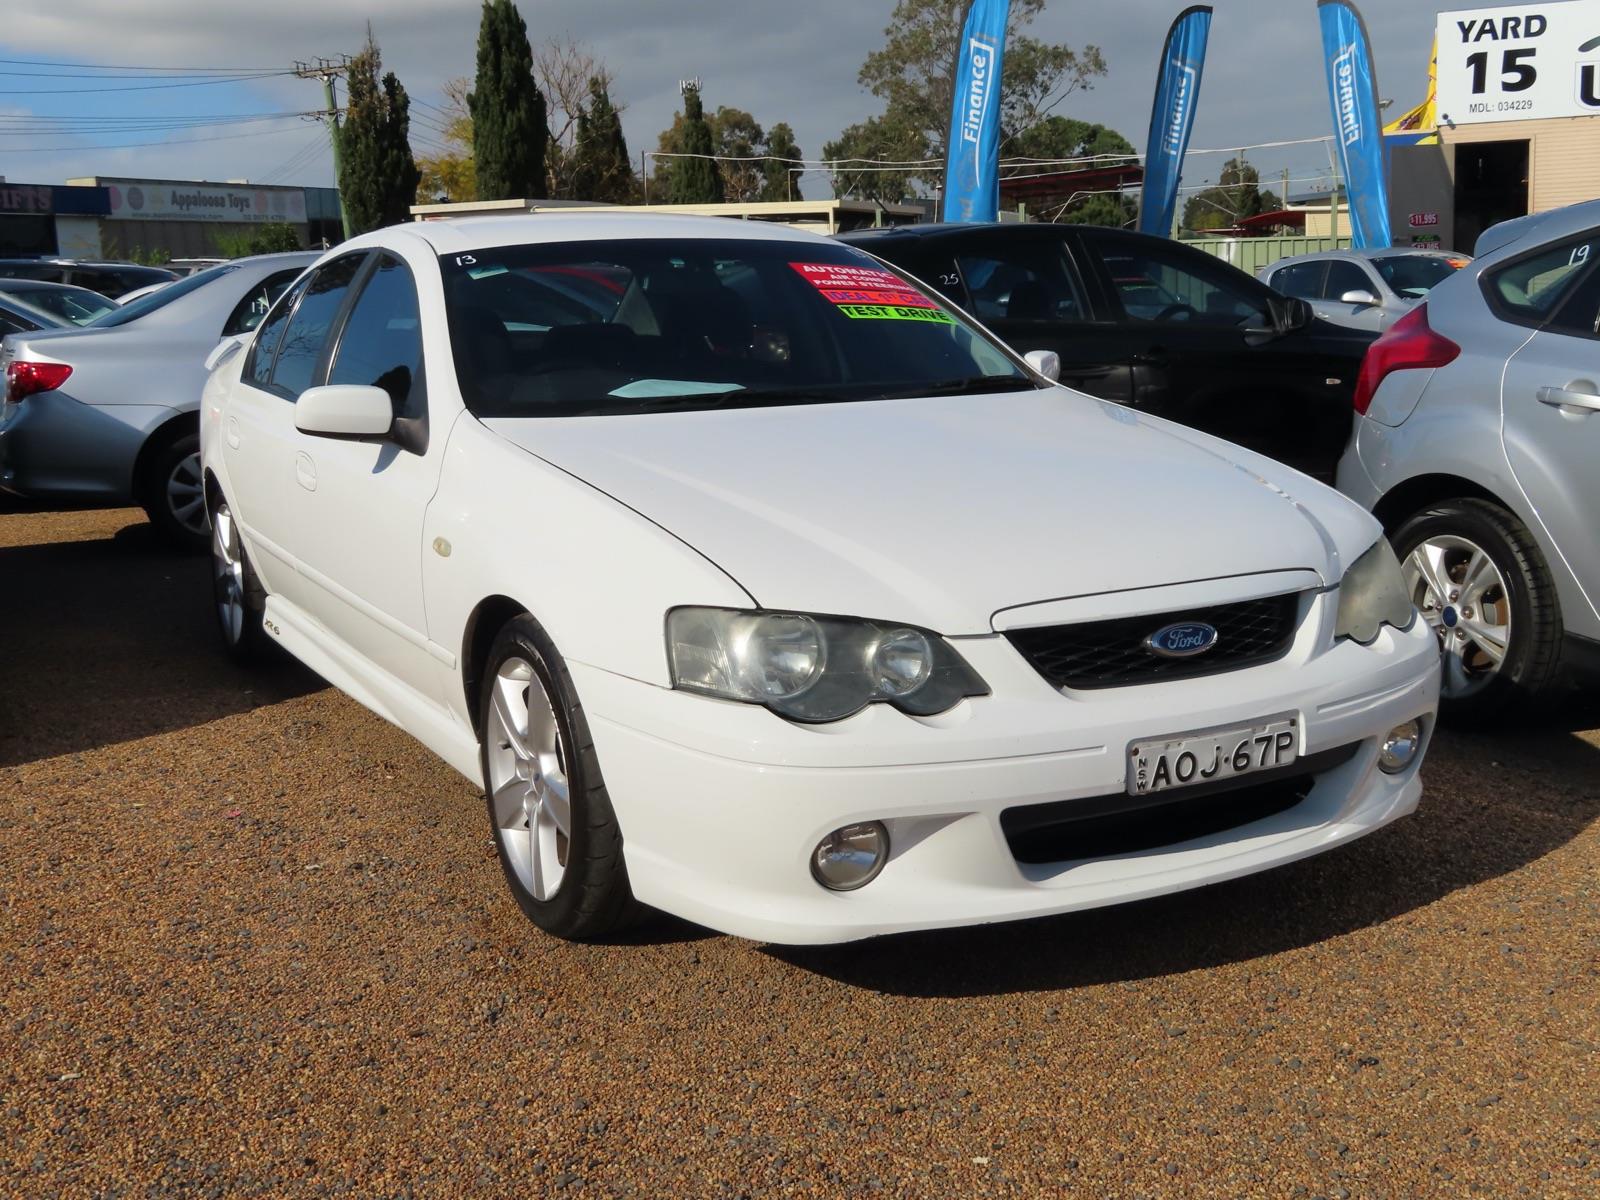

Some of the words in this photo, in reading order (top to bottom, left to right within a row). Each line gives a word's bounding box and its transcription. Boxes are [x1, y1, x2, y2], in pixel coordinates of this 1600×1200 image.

[1457, 14, 1547, 43] YARD
[1466, 48, 1537, 94] 15
[963, 53, 986, 144] Finance
[1469, 103, 1494, 113] MDL:
[1498, 100, 1533, 112] 034229
[1164, 75, 1187, 156] Finance
[171, 190, 226, 211] Appaloosa
[227, 193, 250, 213] Toys
[456, 255, 477, 266] 13
[1568, 244, 1590, 267] 19
[813, 279, 857, 287] POWER
[939, 273, 959, 285] 25
[840, 306, 891, 316] TEST
[893, 307, 951, 321] DRIVE
[1167, 628, 1204, 650] Ford
